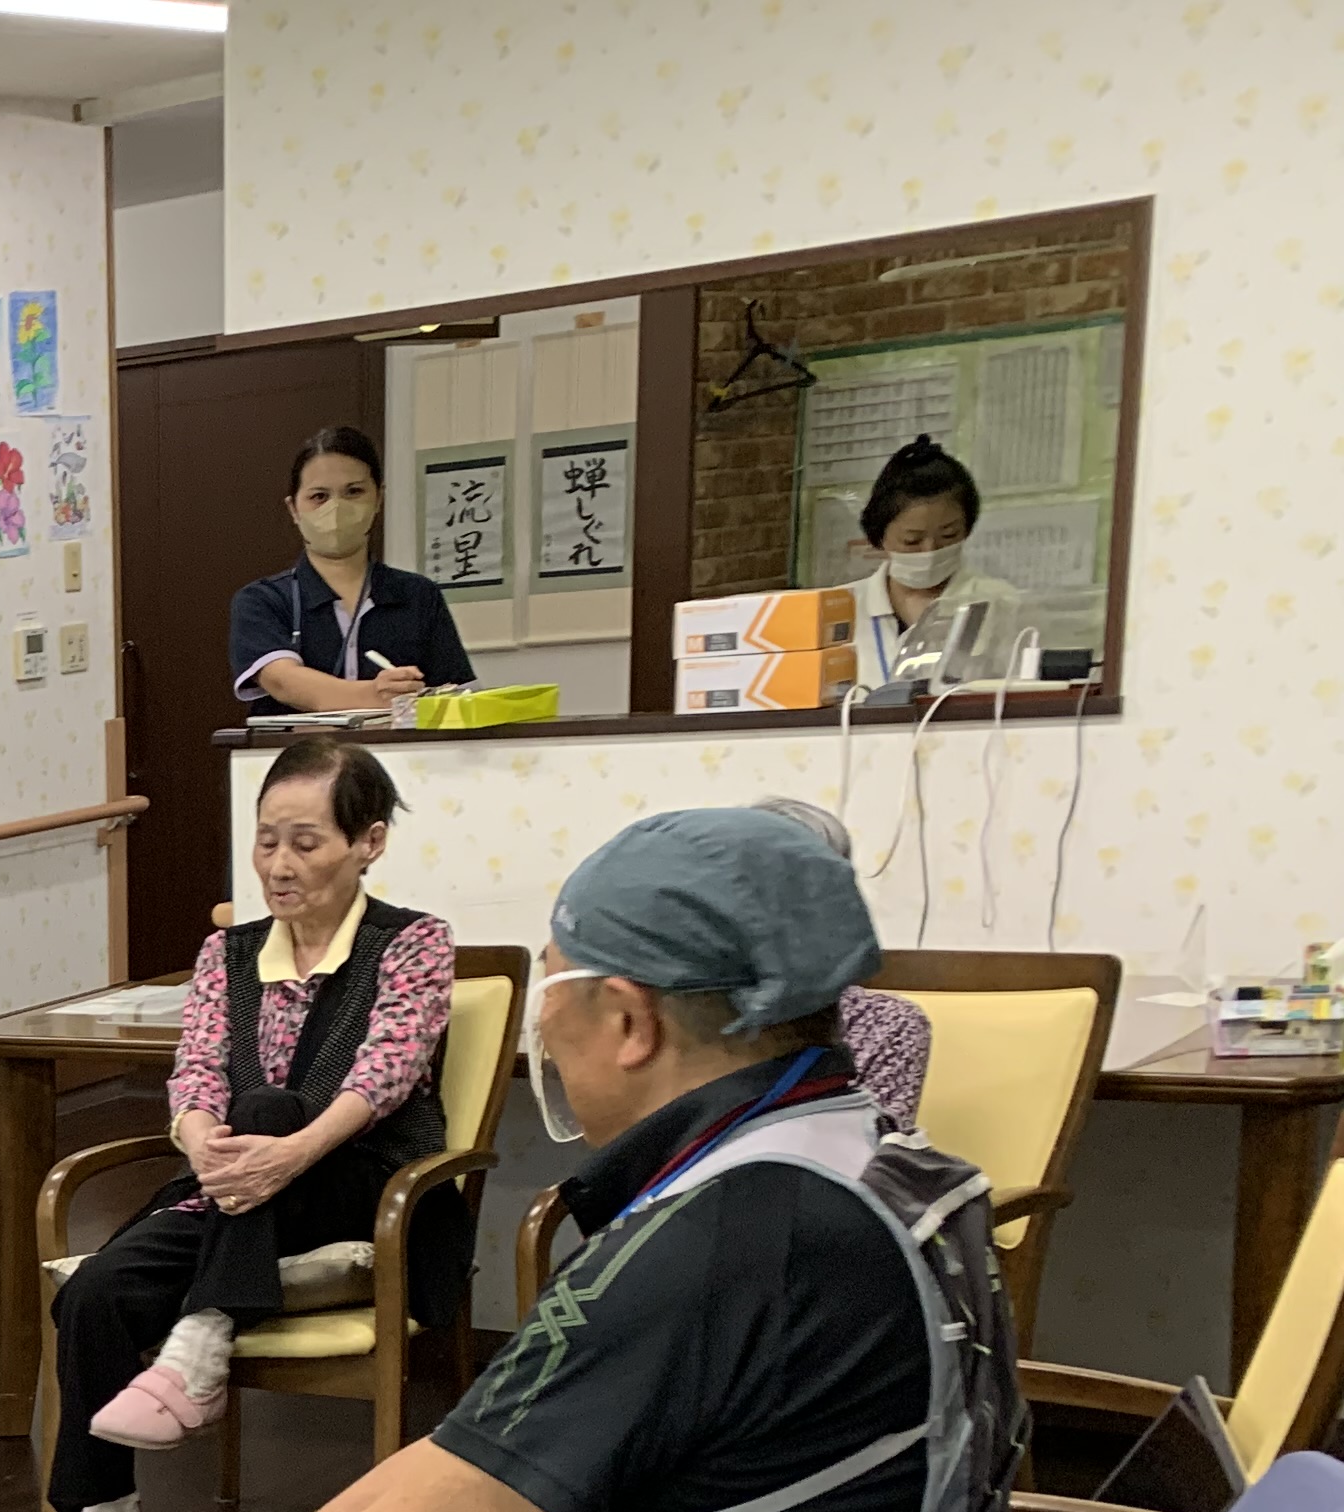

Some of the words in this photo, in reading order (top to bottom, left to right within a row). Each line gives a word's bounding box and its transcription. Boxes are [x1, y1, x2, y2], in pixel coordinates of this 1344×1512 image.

[445, 480, 492, 581] 流星
[563, 457, 610, 567] 蝉しぐれ
